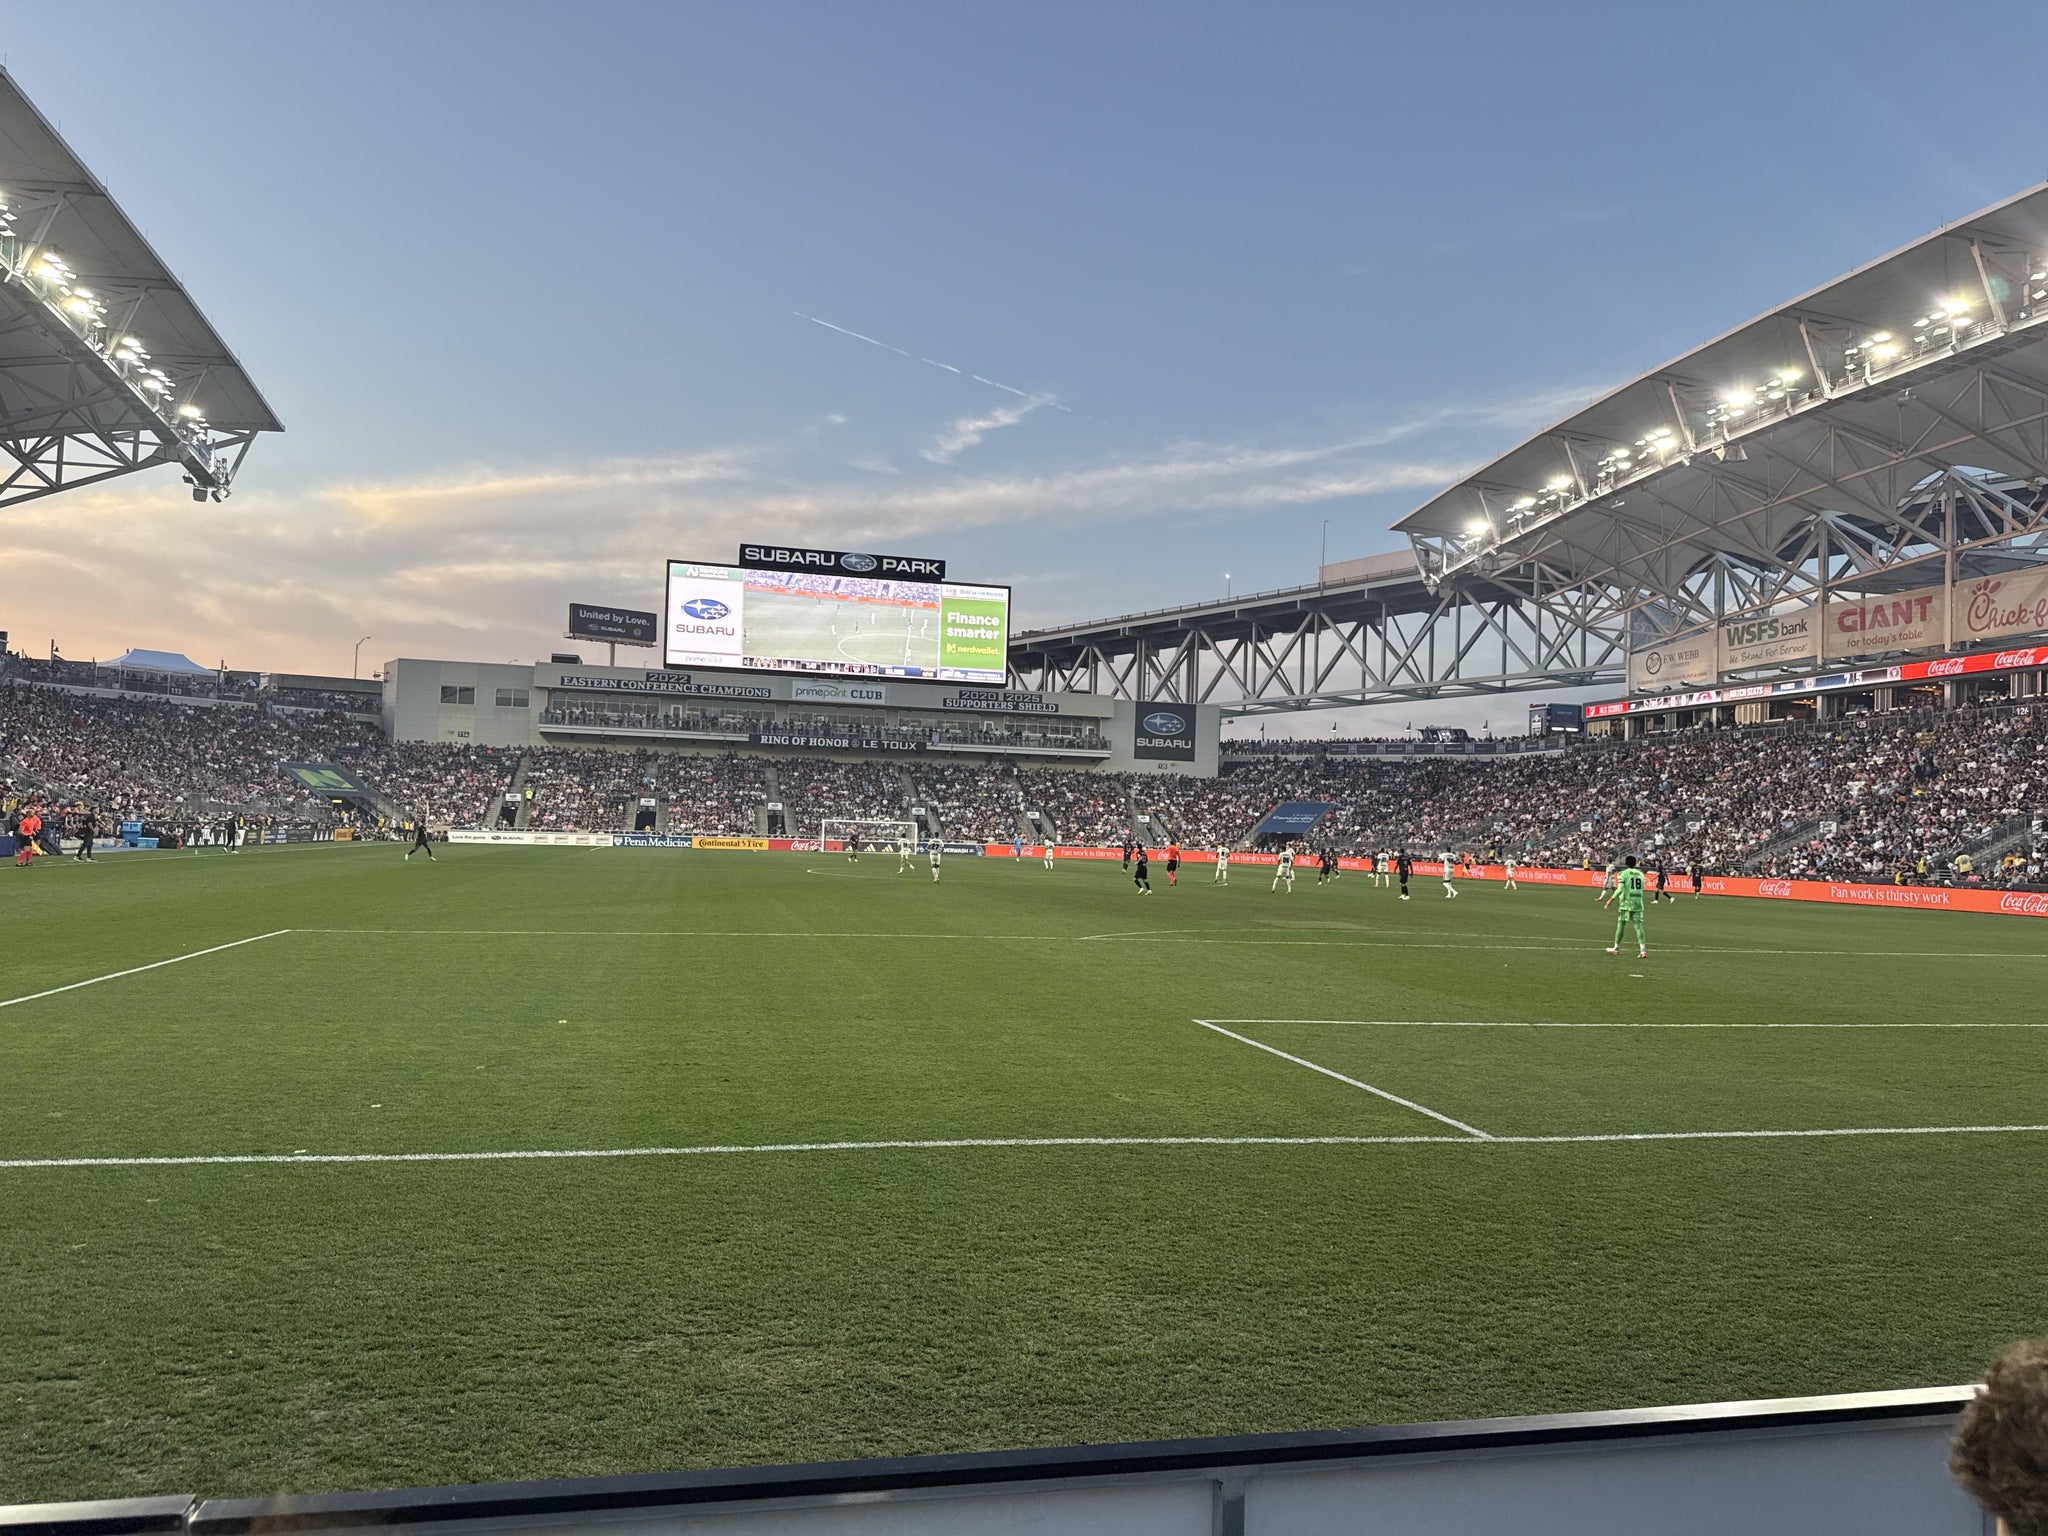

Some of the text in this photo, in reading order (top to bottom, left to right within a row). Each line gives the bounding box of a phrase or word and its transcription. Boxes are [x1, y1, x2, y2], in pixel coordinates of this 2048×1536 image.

[744, 548, 940, 575] SUBARU PARK
[579, 610, 650, 626] United by Love.
[947, 612, 1000, 626] Finance
[1837, 595, 1933, 632] GIANT
[676, 624, 734, 636] SUBARU
[946, 627, 1000, 640] smarter
[1726, 618, 1808, 647] WSFS bank
[1847, 629, 1923, 648] for today's table
[1765, 648, 1778, 657] For
[649, 673, 689, 684] 2022
[1855, 672, 1862, 684] 5
[563, 677, 770, 697] EASTERN CONFERENCE CHAMPIONS
[1747, 686, 1764, 695] STATS
[795, 688, 882, 700] primepoint CLUB
[962, 691, 997, 700] 2020
[1005, 693, 1040, 703] 2025
[946, 698, 1056, 712] SUPPORTERS' SHIELD
[760, 735, 917, 750] RING OF HONOR LE TOUX
[1136, 737, 1192, 749] SUBARU
[624, 837, 691, 847] Penn Medicine
[699, 839, 740, 848] Continental
[1631, 878, 1641, 889] 18
[1706, 881, 1725, 890] work
[1831, 886, 1949, 905] Fan work is thirsty work
